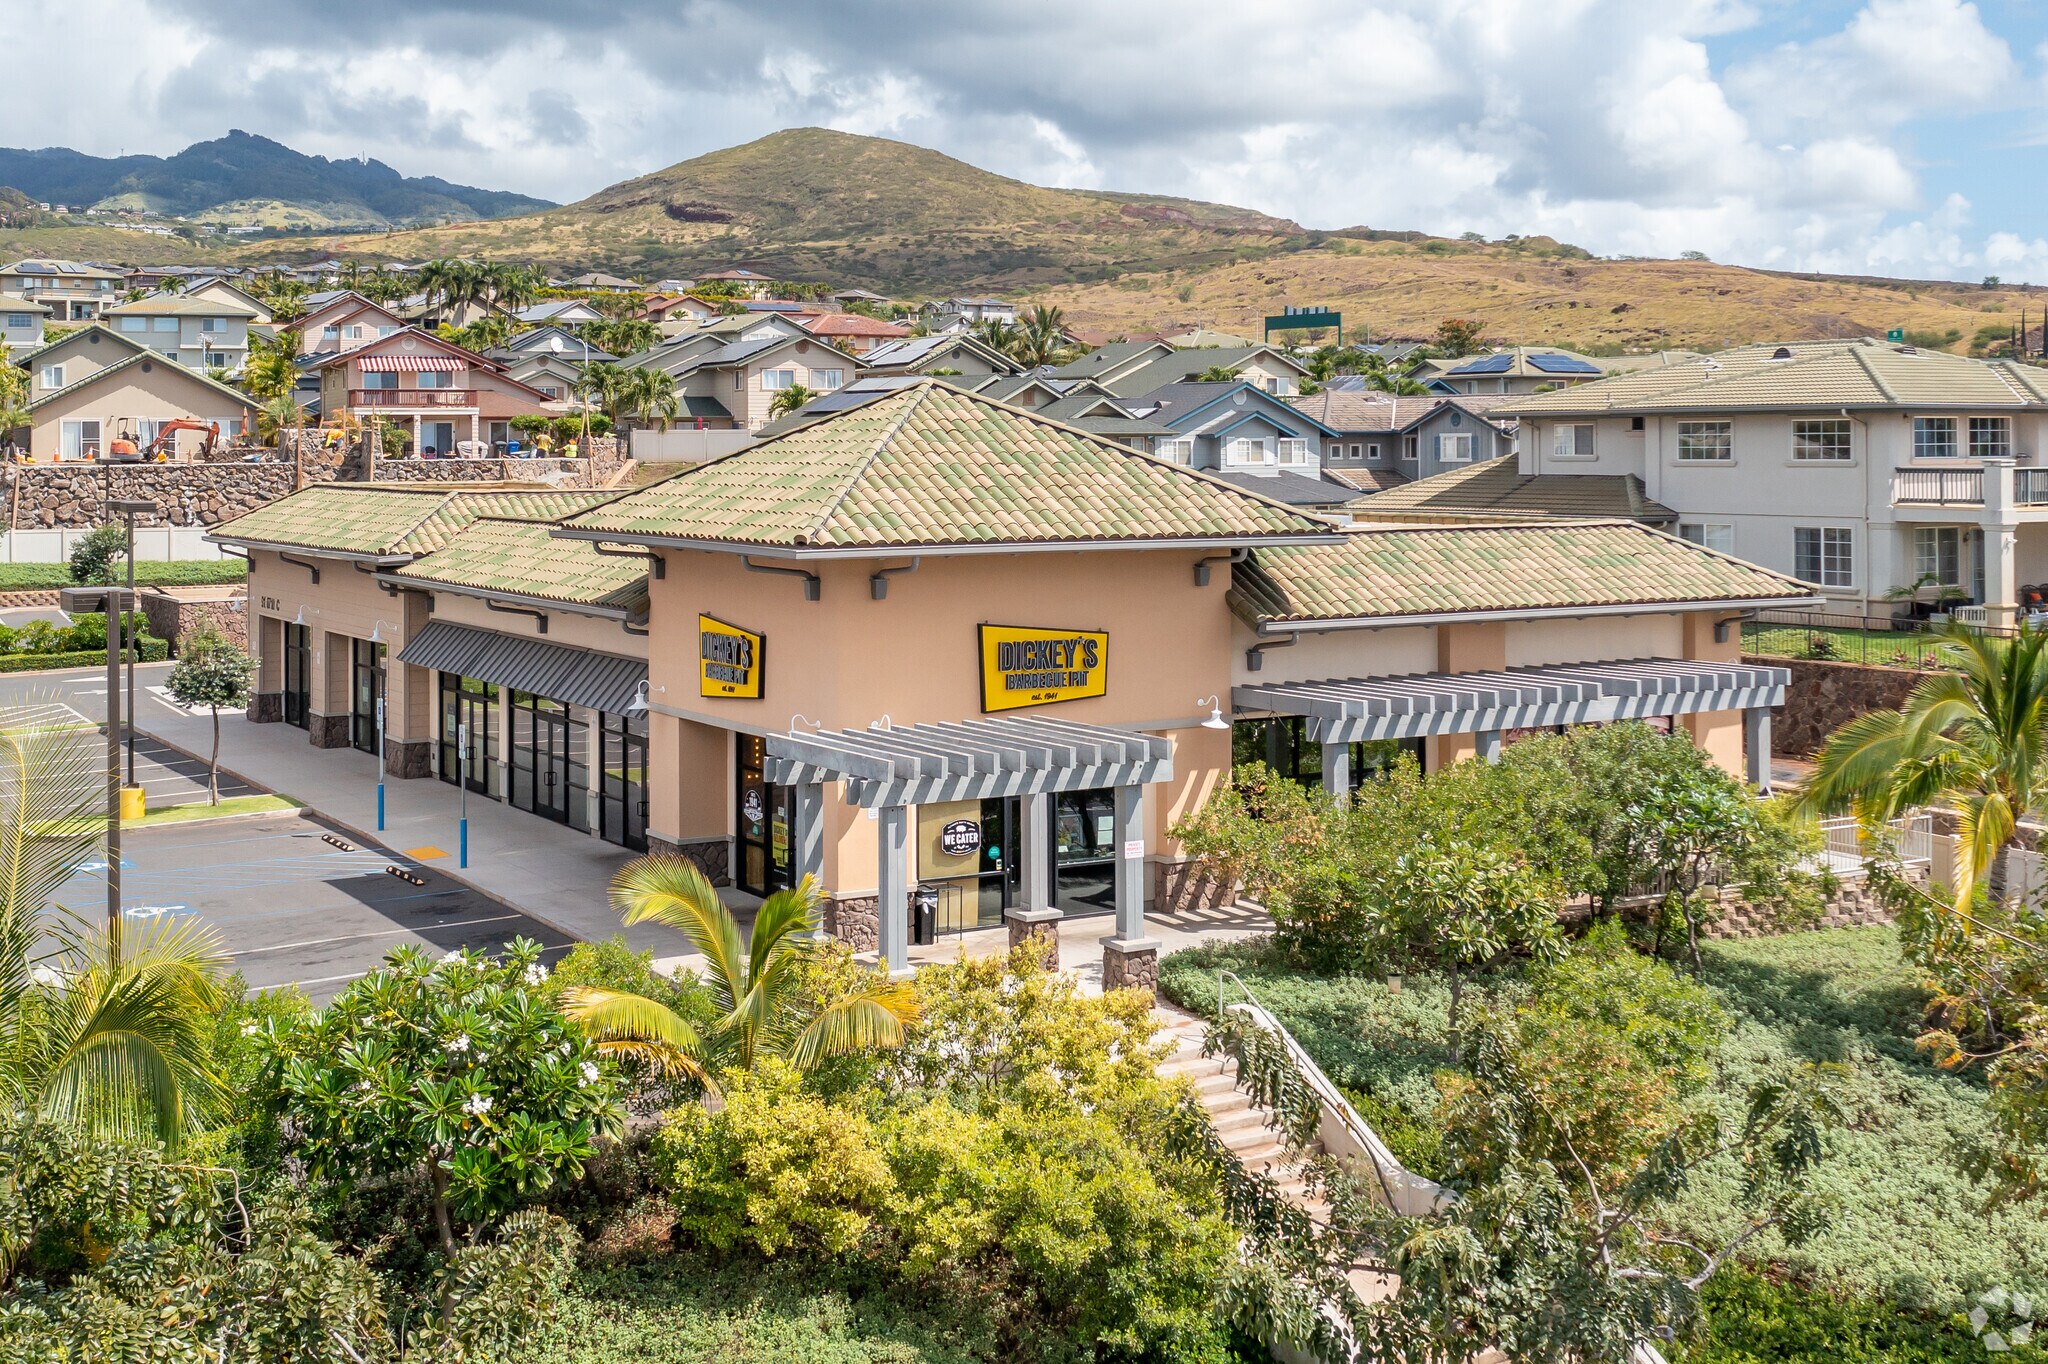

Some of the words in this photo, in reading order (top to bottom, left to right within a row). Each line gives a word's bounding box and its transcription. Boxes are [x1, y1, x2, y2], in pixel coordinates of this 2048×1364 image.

[701, 631, 753, 670] DICKEY'S
[998, 636, 1099, 672] DICKEY'S
[1006, 675, 1067, 691] BARBECUE
[1068, 670, 1090, 688] PIT
[1031, 693, 1043, 701] est.
[1044, 692, 1058, 700] 1941
[944, 834, 956, 846] WE
[955, 832, 979, 845] CATER
